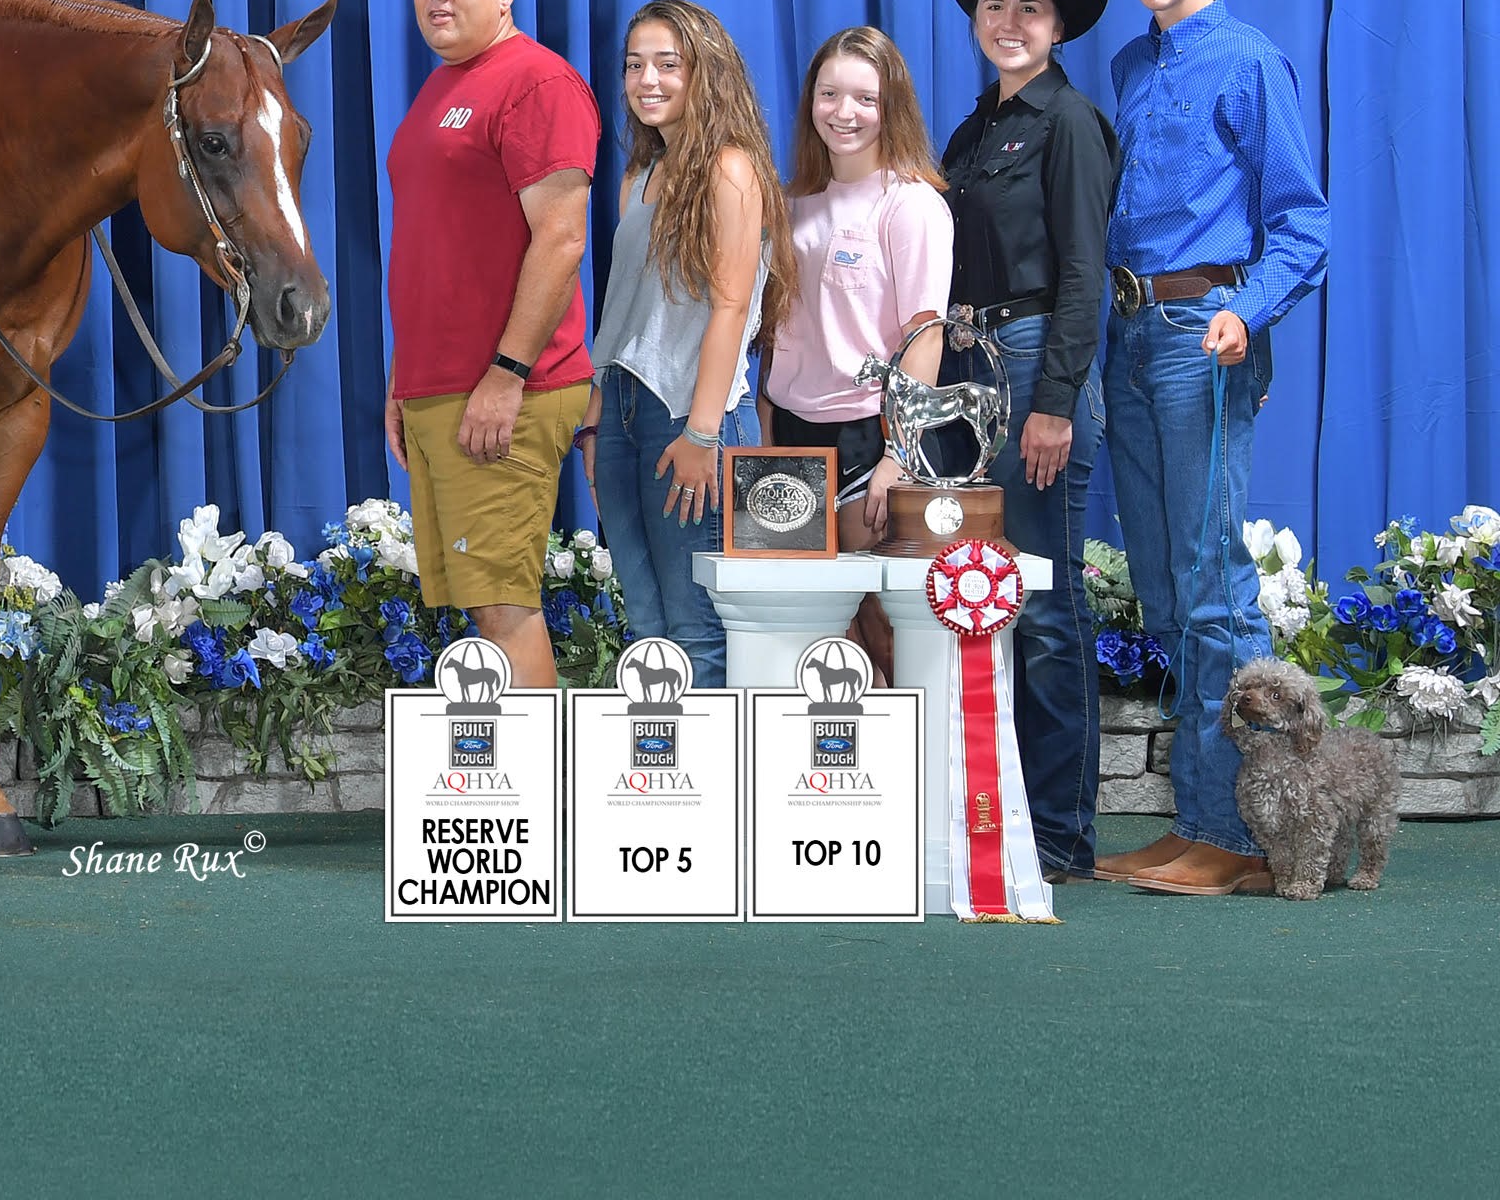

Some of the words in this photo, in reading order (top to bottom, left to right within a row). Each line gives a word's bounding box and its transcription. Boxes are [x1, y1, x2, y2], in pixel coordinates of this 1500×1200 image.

[453, 723, 492, 737] BUILT
[635, 723, 674, 737] BUILT
[815, 723, 855, 737] BUILT
[453, 753, 492, 764] TOUGH
[635, 753, 674, 764] TOUGH
[815, 753, 854, 764] TOUGH
[432, 772, 513, 793] AQHYA
[614, 772, 694, 793] AQHYA
[794, 772, 875, 793] AQHYA
[422, 818, 529, 844] RESERVE
[427, 848, 522, 874] WORLD
[619, 846, 669, 873] TOP
[676, 847, 692, 873] 5
[792, 840, 841, 866] TOP
[852, 840, 882, 866] 10
[398, 878, 550, 905] CHAMPION
